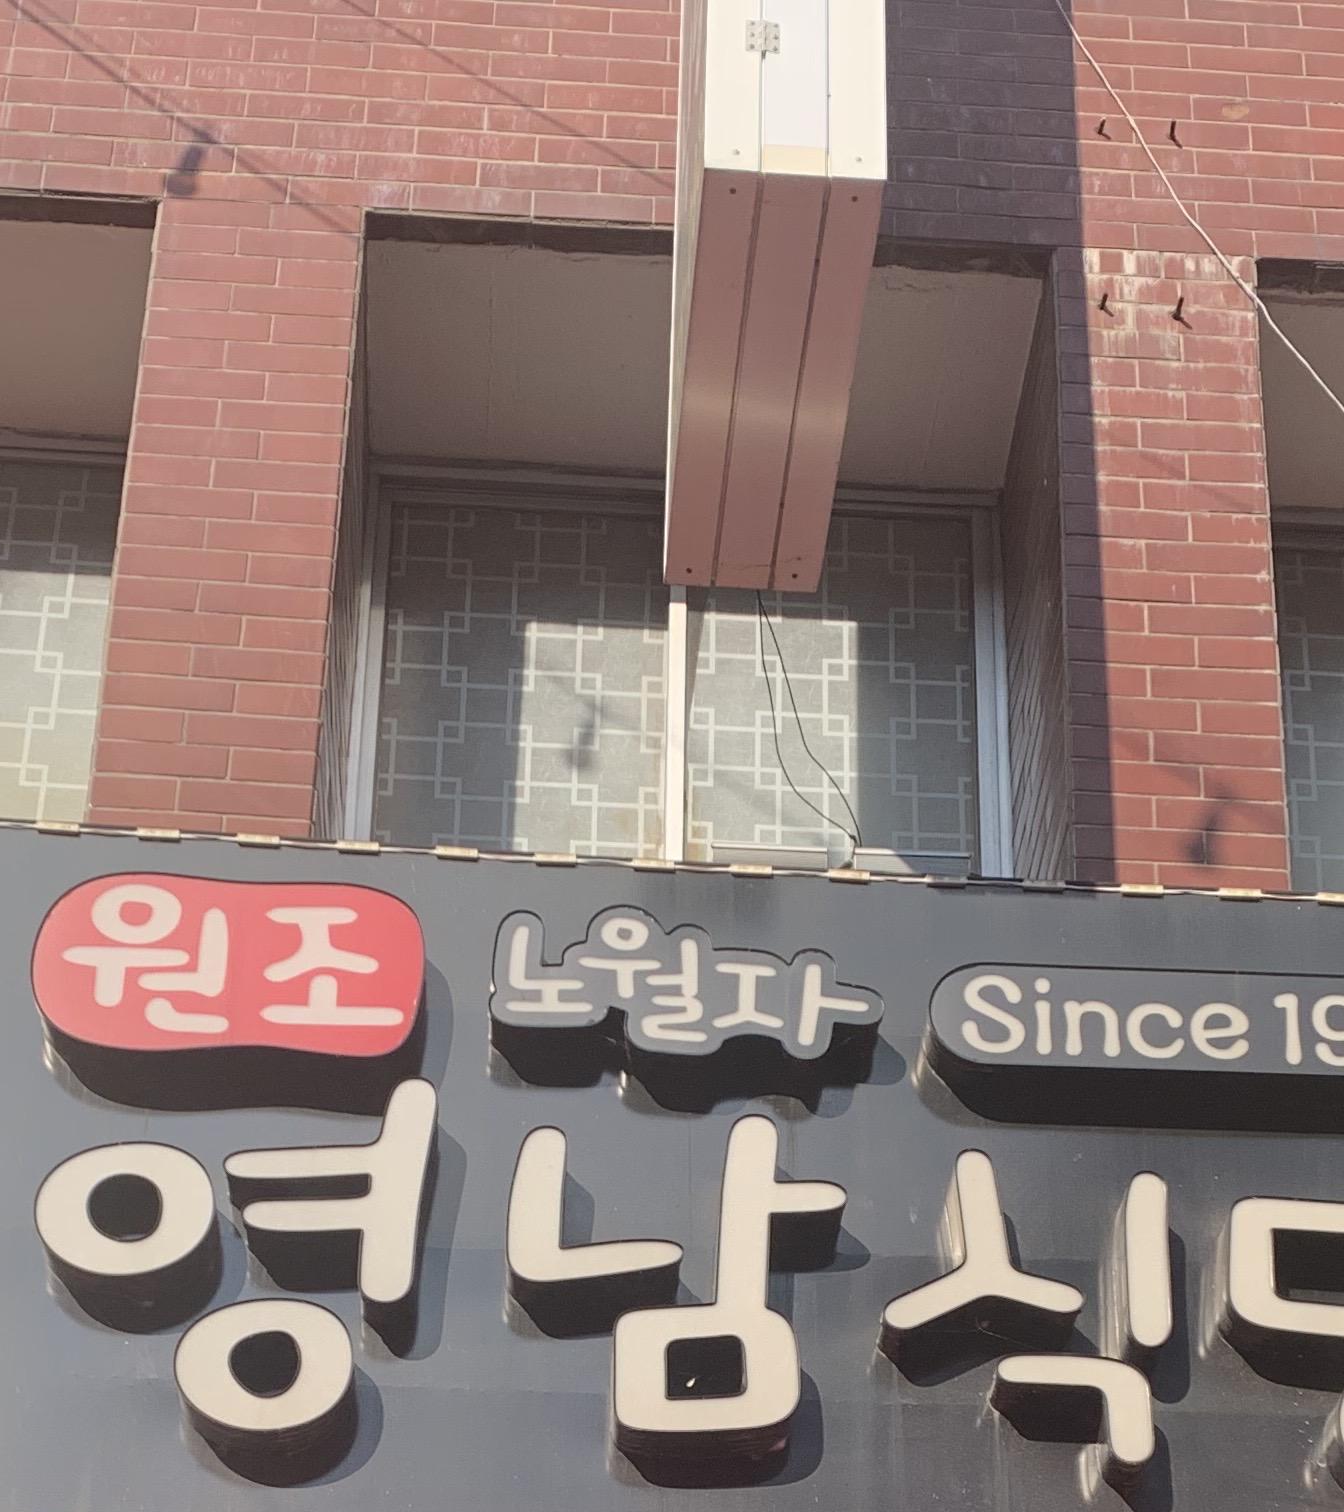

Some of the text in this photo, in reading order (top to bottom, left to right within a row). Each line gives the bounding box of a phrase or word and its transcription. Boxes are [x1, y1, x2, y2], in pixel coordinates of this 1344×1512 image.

[61, 883, 870, 1048] 원조 노월자
[960, 973, 1251, 1060] Since
